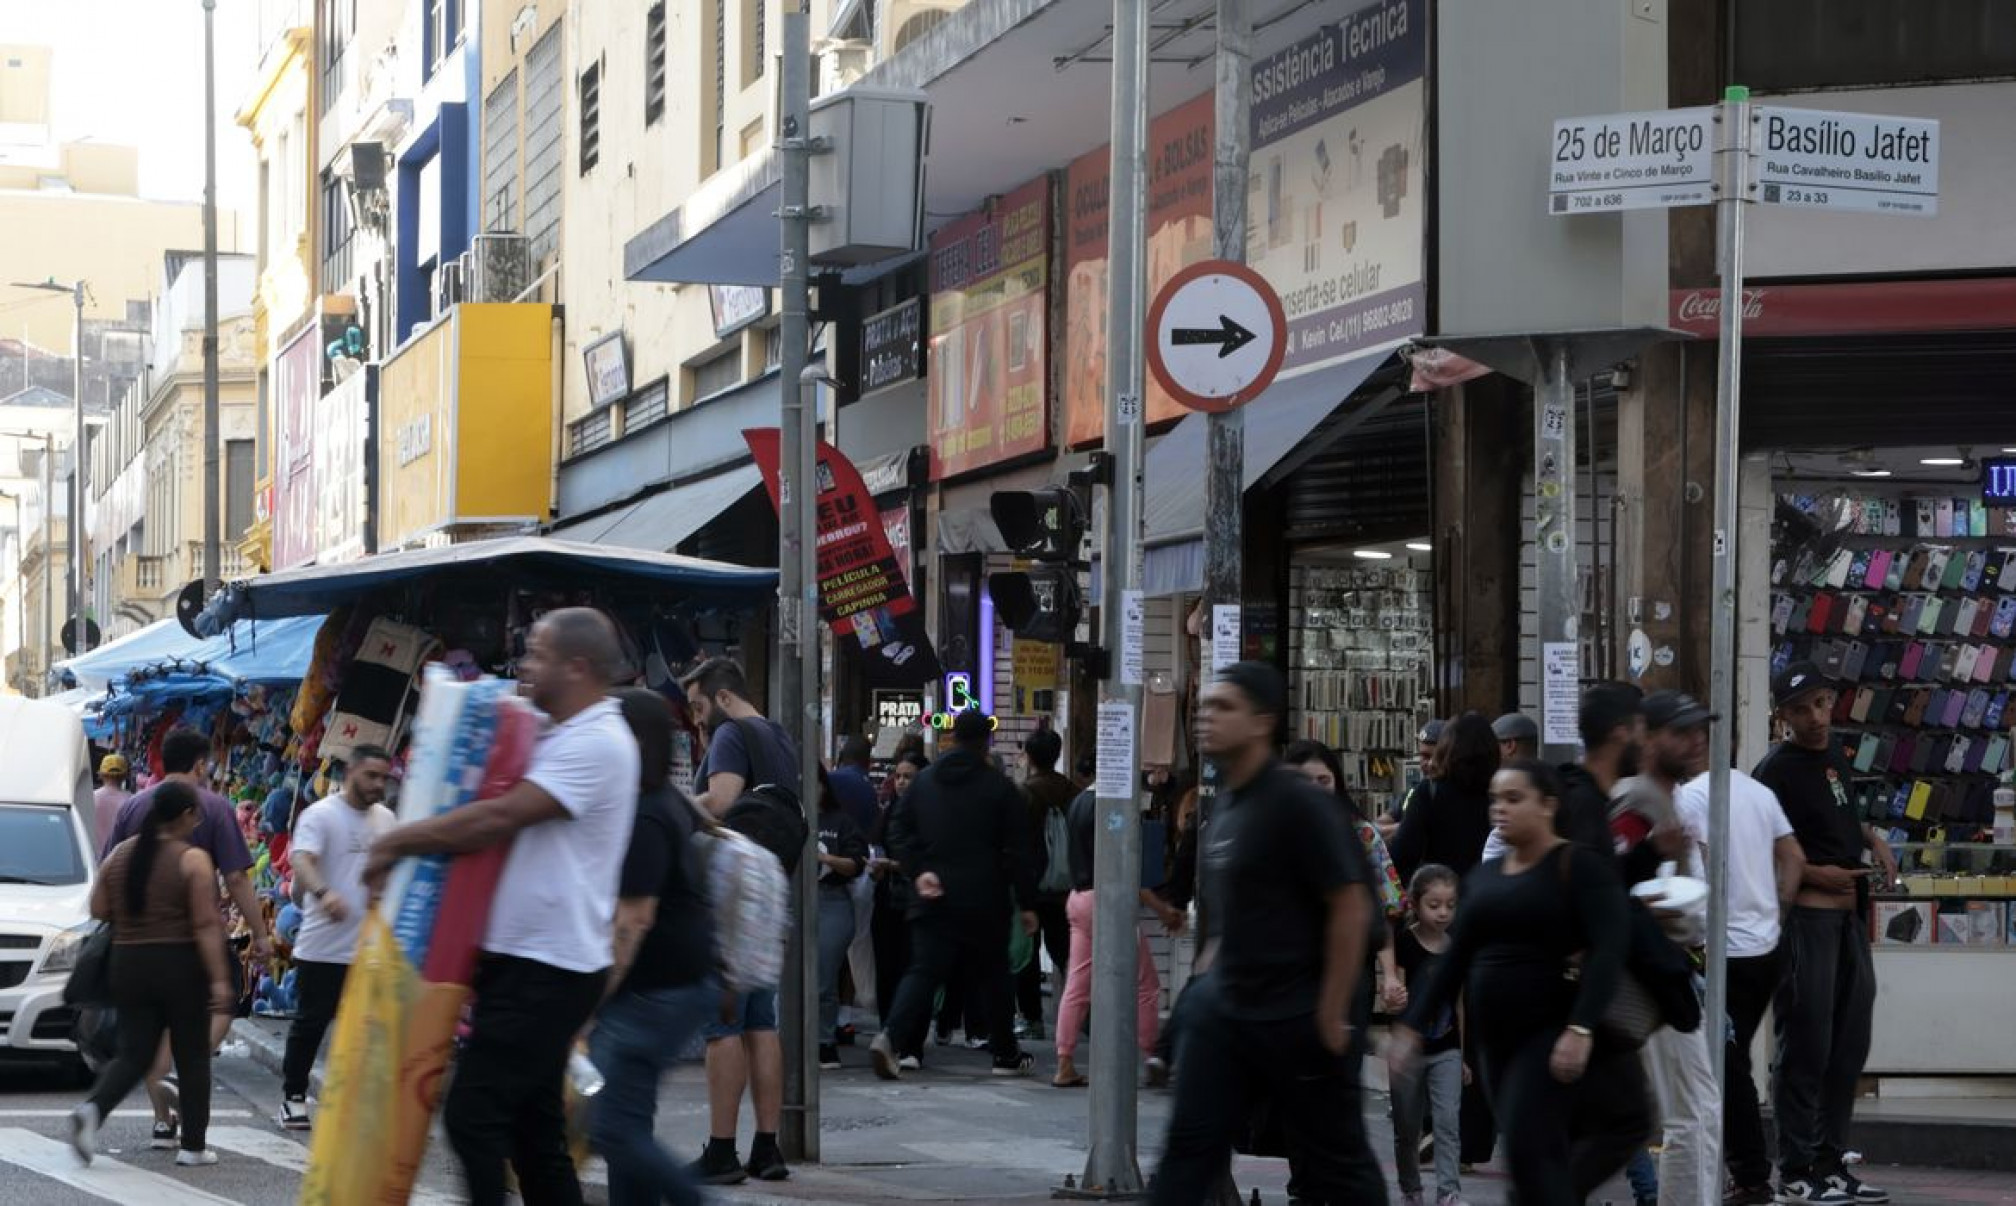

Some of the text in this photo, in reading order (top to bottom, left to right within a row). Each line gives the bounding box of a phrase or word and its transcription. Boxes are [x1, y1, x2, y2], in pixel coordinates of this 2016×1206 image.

[1251, 0, 1408, 105] ssistência Técnica
[1557, 121, 1703, 162] 25 de Março
[1768, 116, 1931, 163] Basílio Jafet
[1076, 174, 1109, 218] ÓCULO
[1164, 124, 1208, 176] BOLSAS
[1555, 164, 1693, 184] Rua Vinte e Cinco de Março
[1767, 161, 1789, 174] Rua
[1792, 163, 1851, 180] Cavalheiro
[1894, 172, 1921, 185] Jafet
[1787, 190, 1828, 204] 23 a 33
[1284, 259, 1381, 317] nserta-se celular
[817, 493, 857, 518] EU
[823, 565, 880, 591] PELÍCULA
[826, 577, 888, 604] CARREGADOR
[880, 702, 920, 716] PRATA
